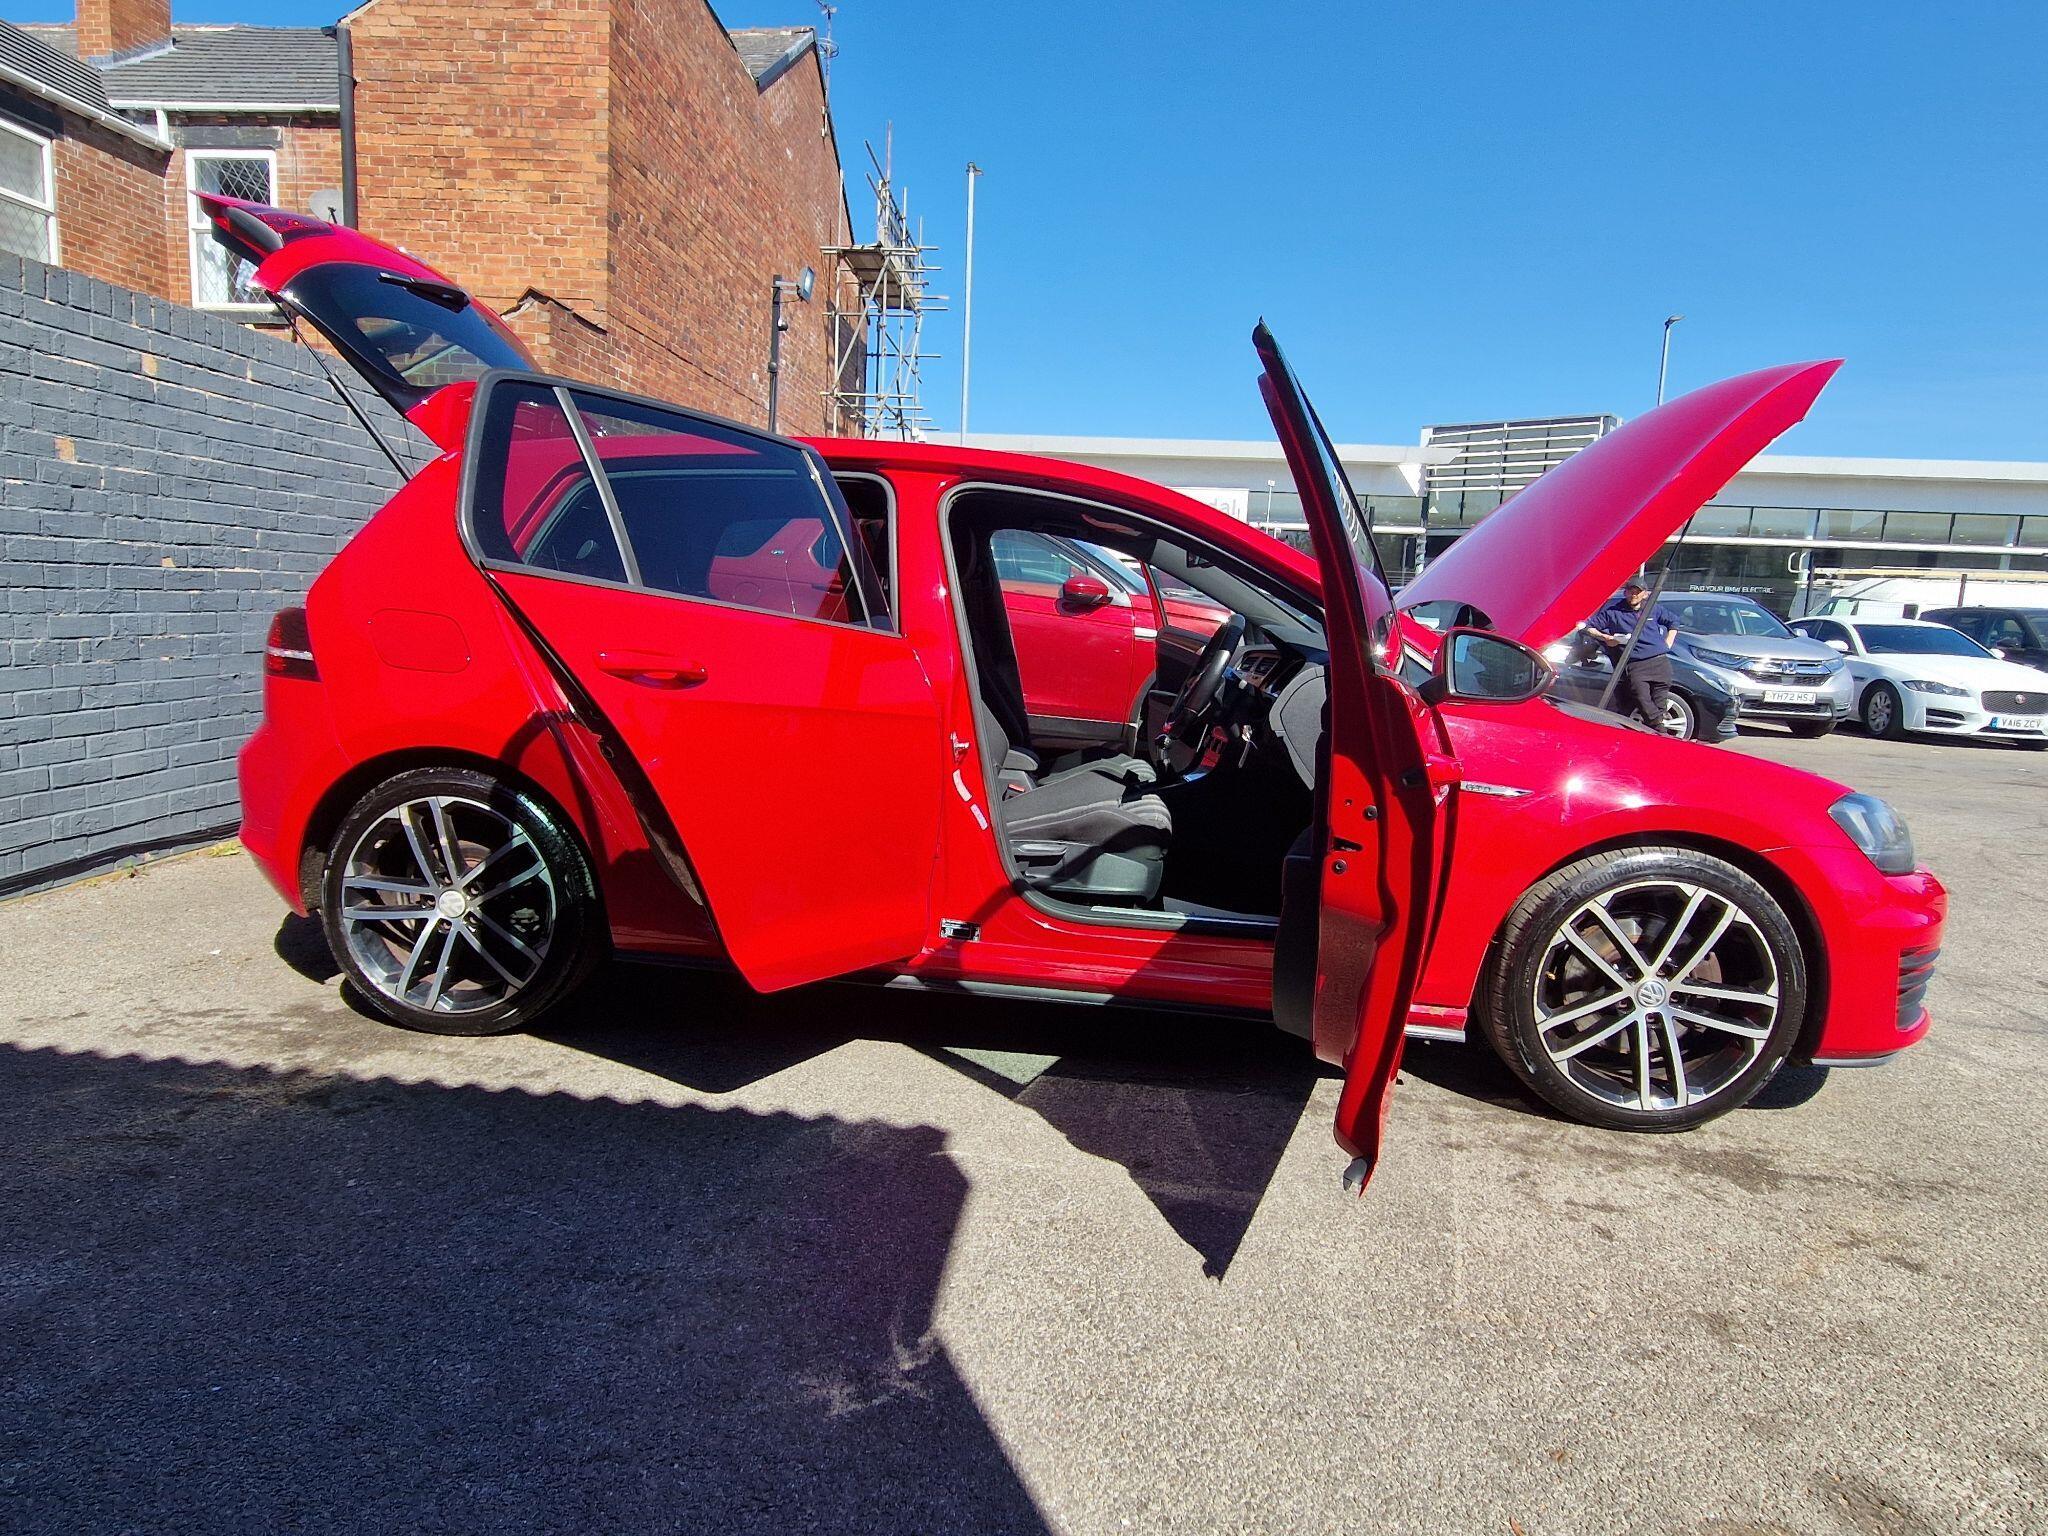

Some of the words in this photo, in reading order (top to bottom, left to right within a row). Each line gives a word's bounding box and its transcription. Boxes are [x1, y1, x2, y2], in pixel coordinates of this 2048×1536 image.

[1689, 584, 1705, 592] FIND
[1773, 692, 1795, 701] YH72
[2001, 718, 2022, 728] VA16
